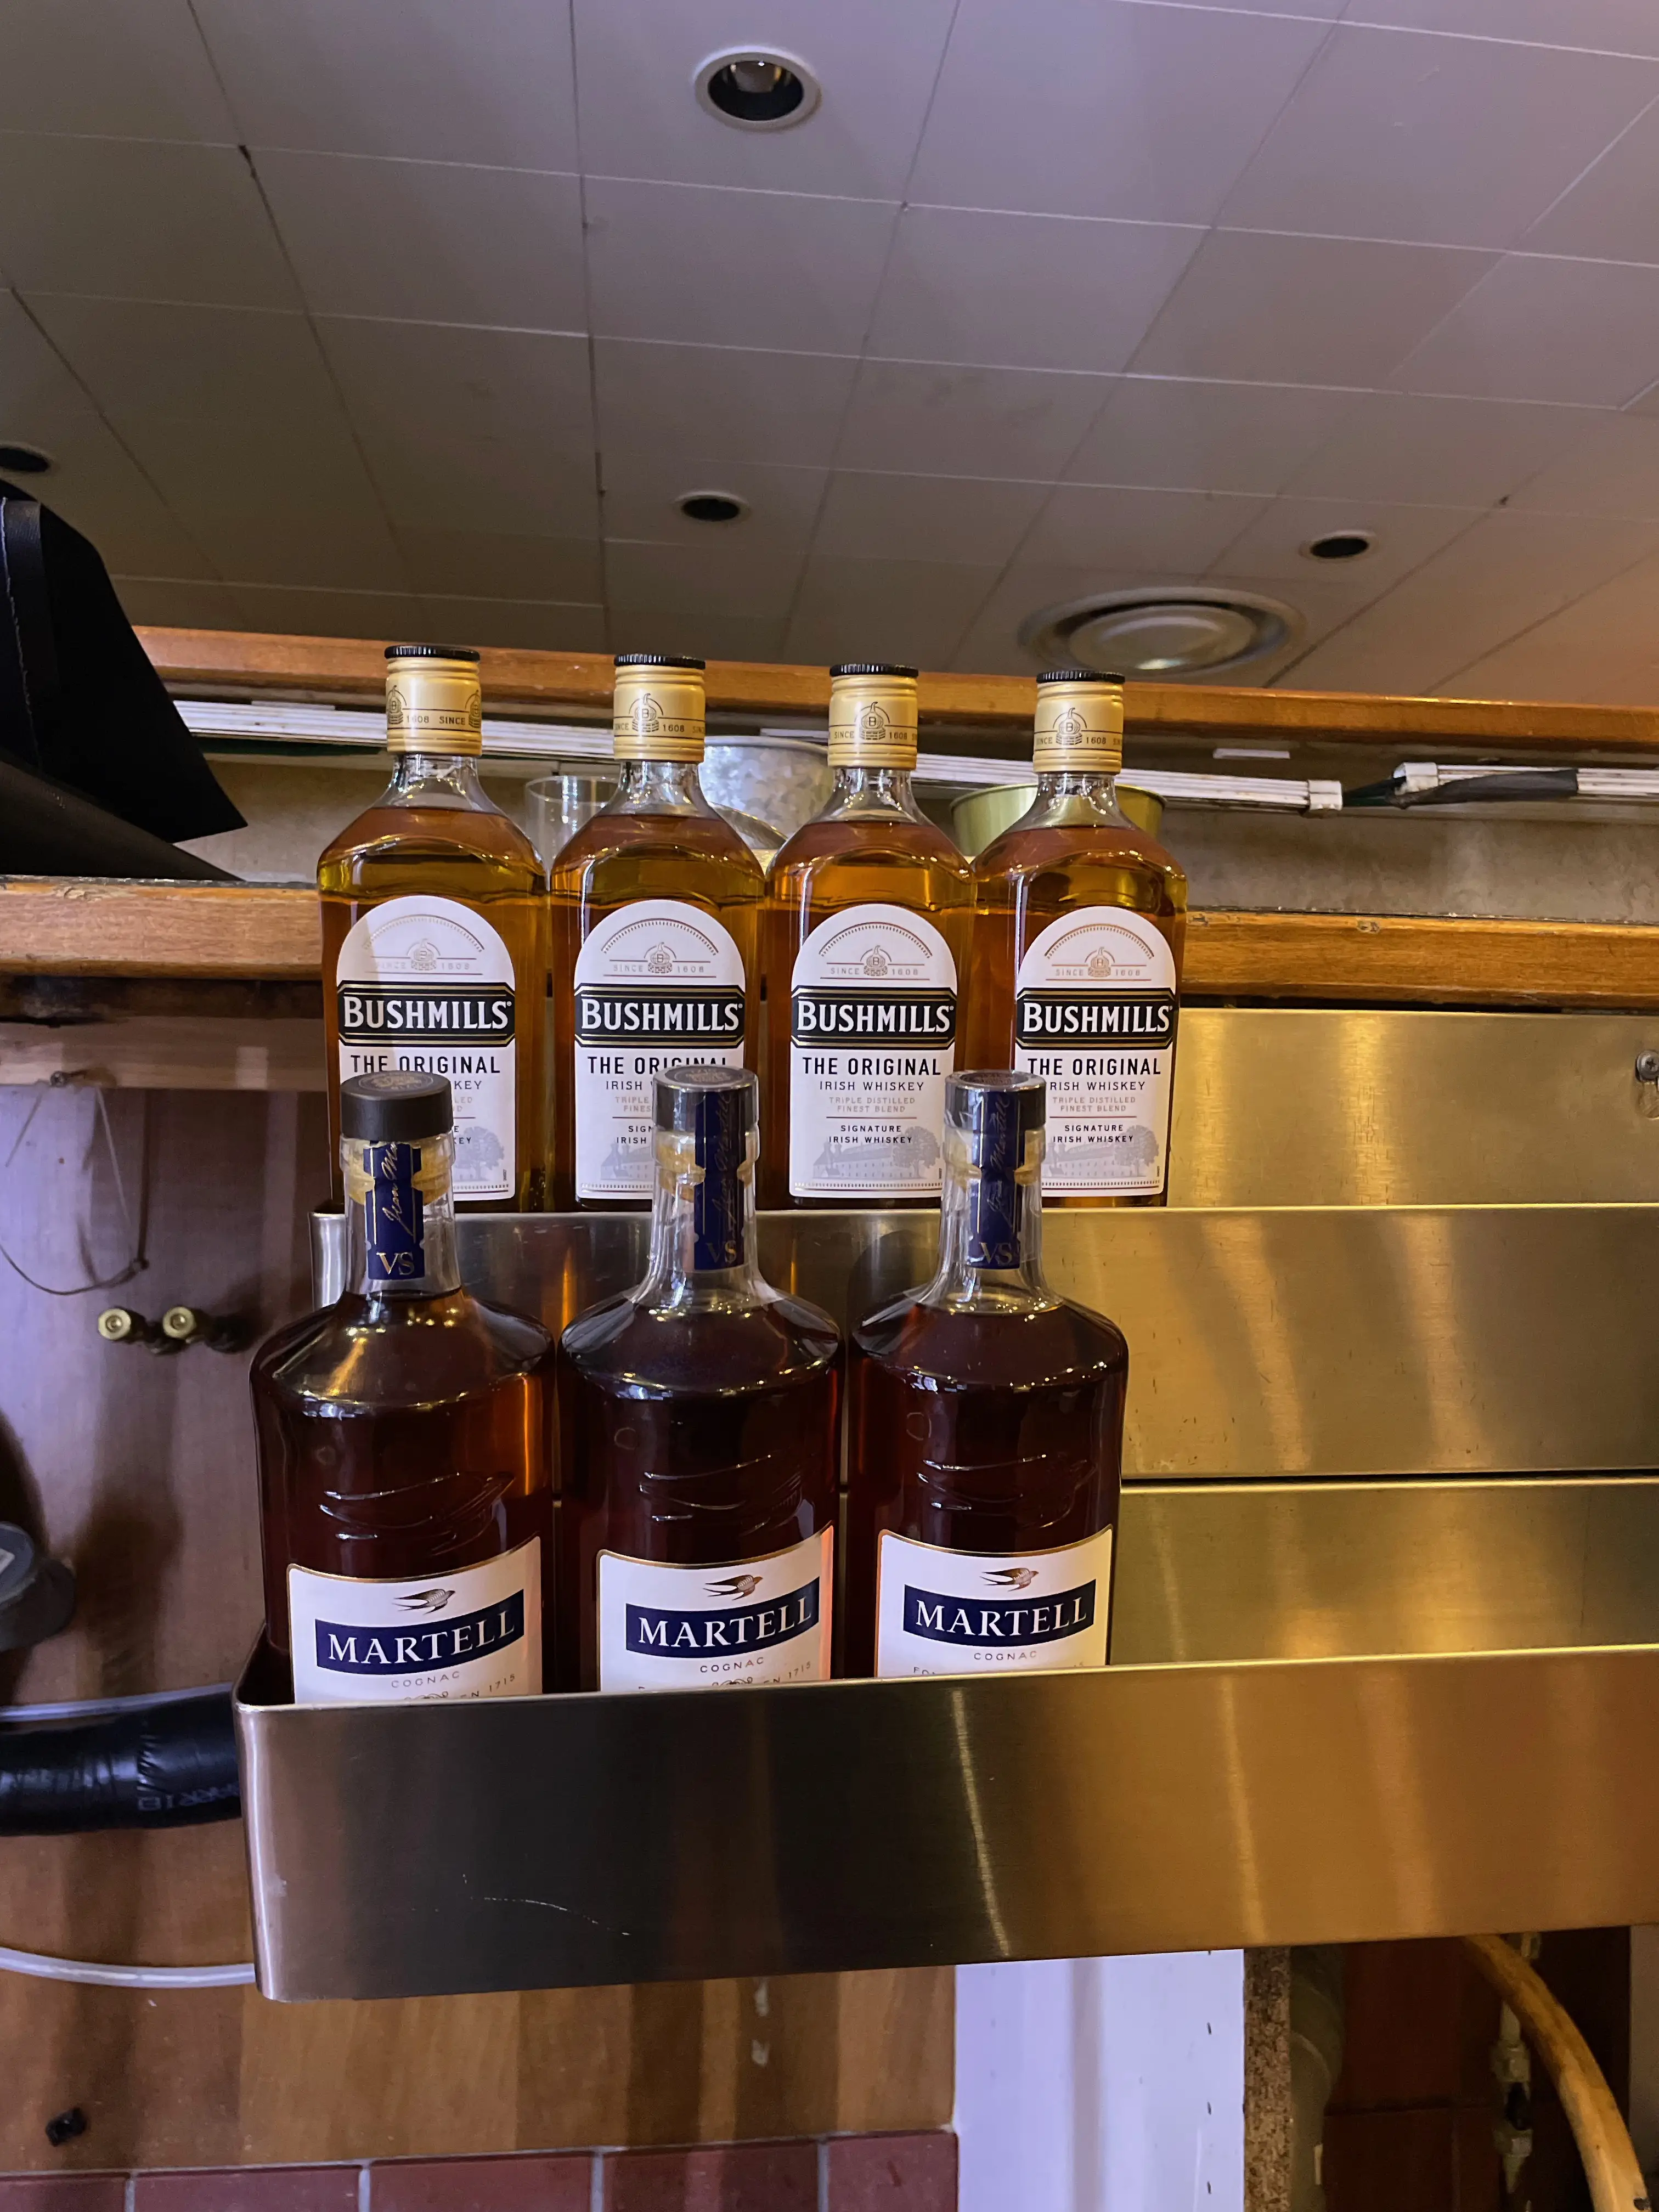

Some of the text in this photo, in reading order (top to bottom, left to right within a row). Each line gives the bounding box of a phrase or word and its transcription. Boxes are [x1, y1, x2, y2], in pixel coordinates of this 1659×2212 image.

[439, 716, 466, 726] SINCE
[663, 724, 685, 732] 1608
[868, 716, 877, 727] B
[1066, 722, 1074, 732] B
[834, 731, 854, 739] SINCE
[1086, 736, 1107, 745] 1608
[613, 964, 643, 972] SINCE
[872, 957, 879, 966] B
[343, 996, 509, 1029] BUSHMILLS
[581, 998, 739, 1031] BUSHMILLS
[797, 1000, 950, 1032] BUSHMILLS
[1023, 1002, 1169, 1033] BUSHMILLS
[351, 1055, 500, 1074] THE ORIGINAL
[588, 1056, 624, 1074] THE
[803, 1057, 941, 1076] THE ORIGINAL
[1028, 1058, 1161, 1075] THE ORIGINAL
[606, 1081, 642, 1090] IRISH
[820, 1081, 924, 1091] IRISH WHISKEY
[1049, 1081, 1146, 1091] RISH WHISKEY
[705, 1239, 737, 1264] VS
[980, 1242, 1013, 1266] VS
[376, 1251, 415, 1276] VS
[637, 1595, 811, 1647] MARTELL
[916, 1596, 1087, 1637] MARTELL
[328, 1609, 515, 1664] MARTELL
[974, 1650, 1037, 1661] COGNAC
[699, 1657, 764, 1673] COGNAC
[788, 1661, 811, 1679] 1715
[391, 1671, 460, 1688] COGNAC
[489, 1673, 515, 1692] 1715
